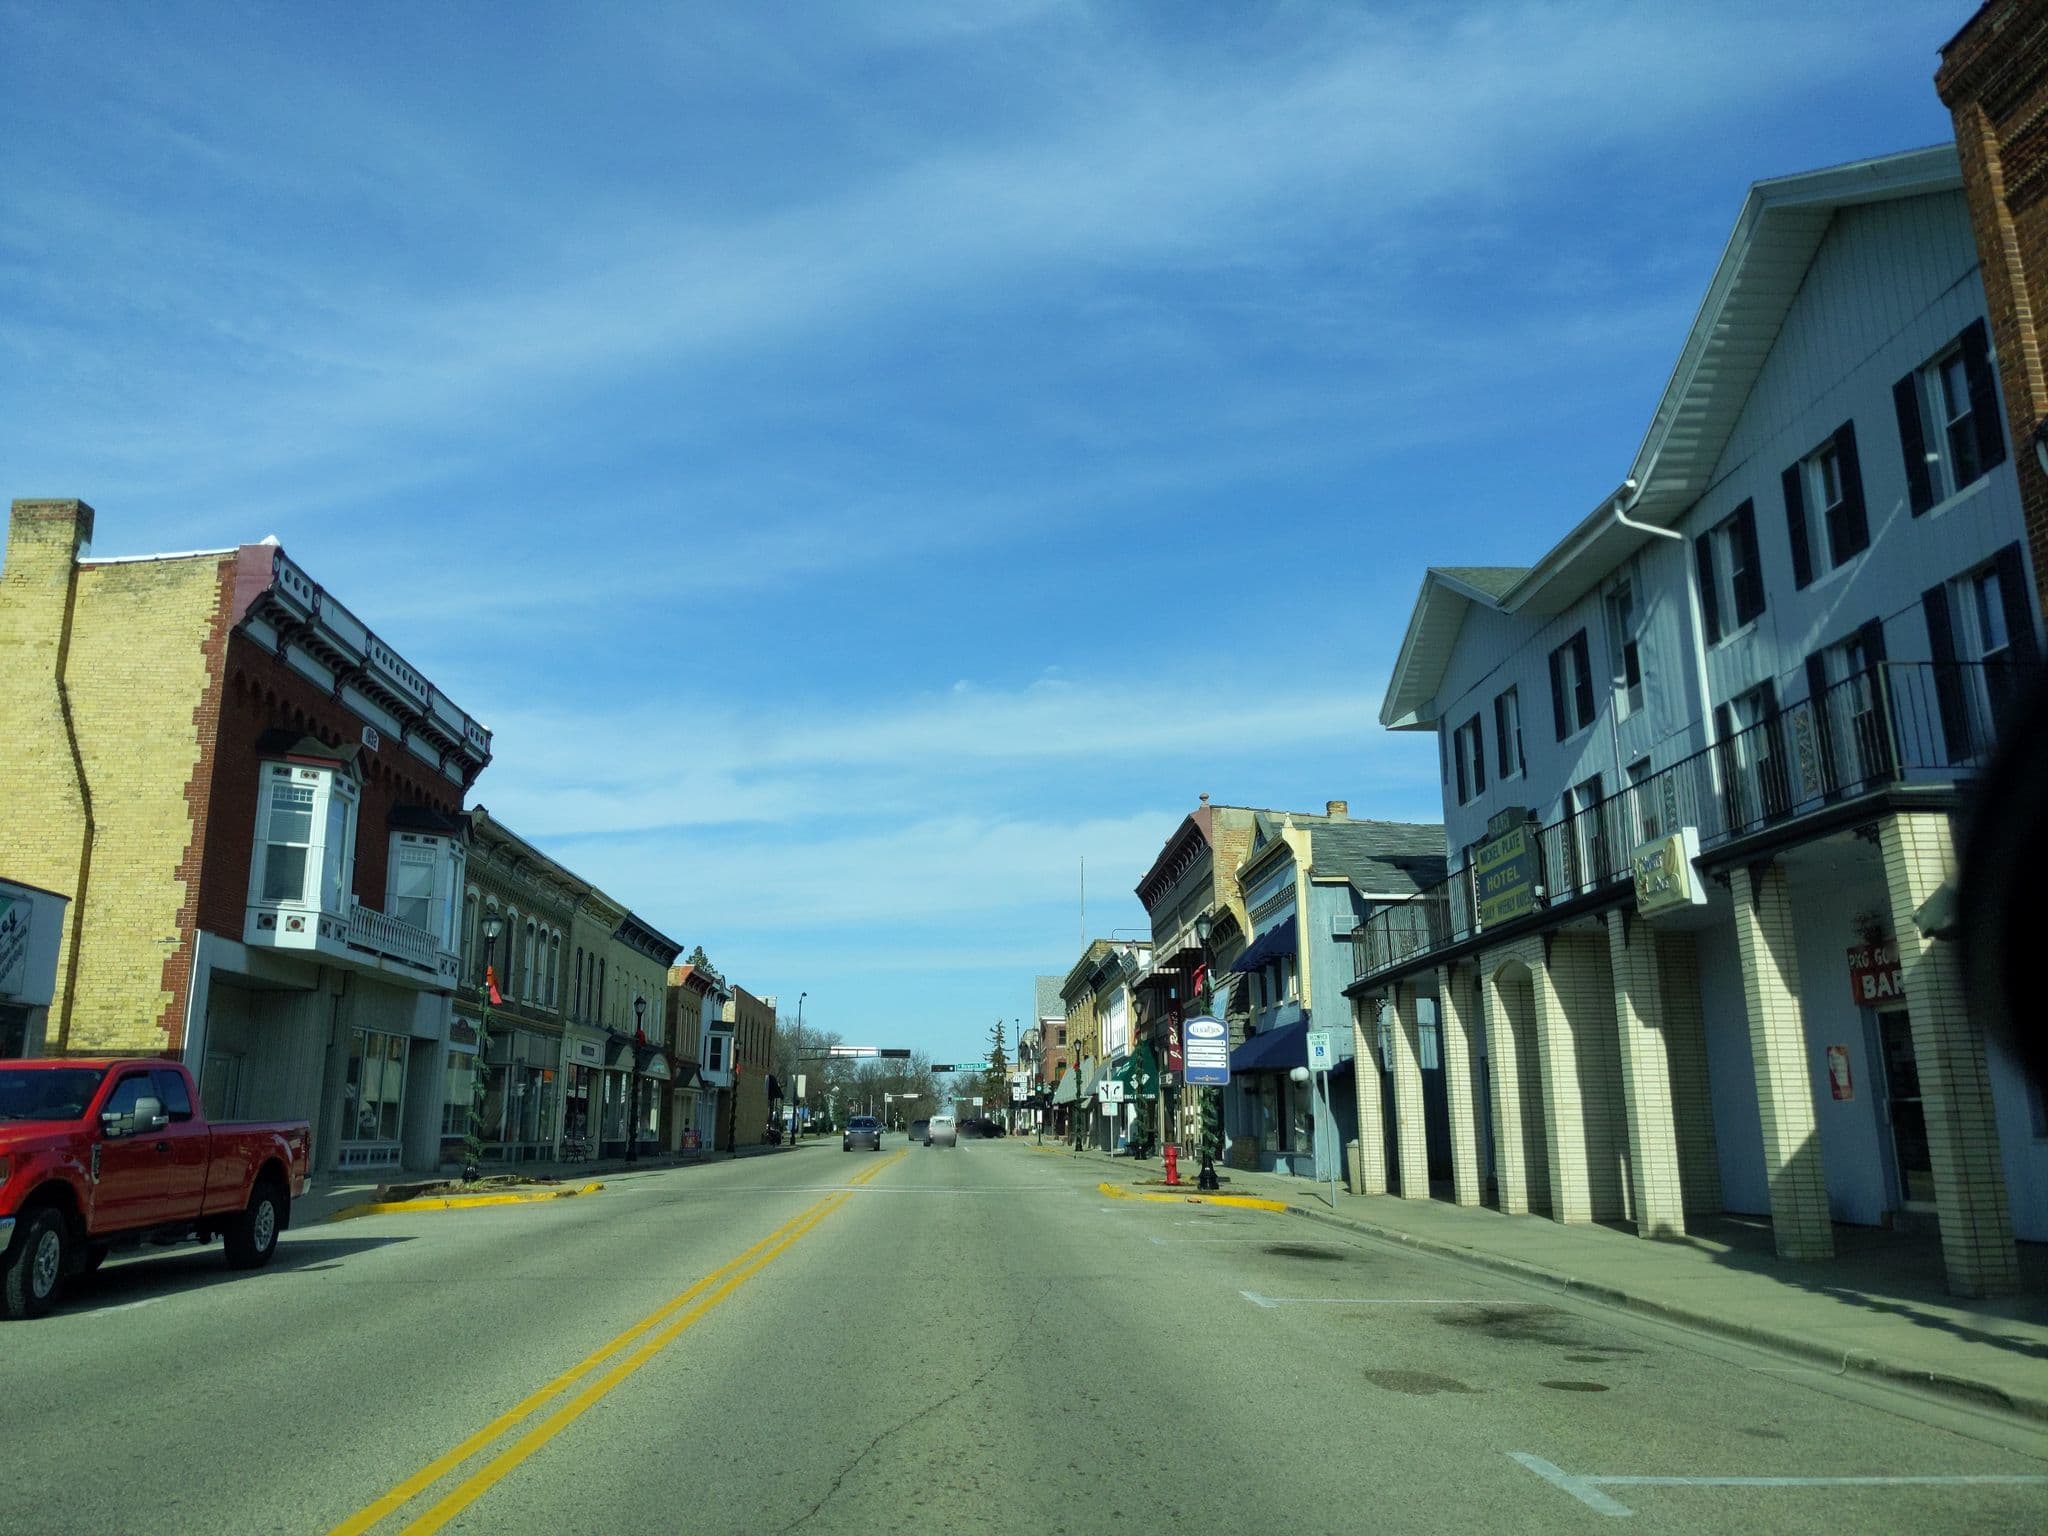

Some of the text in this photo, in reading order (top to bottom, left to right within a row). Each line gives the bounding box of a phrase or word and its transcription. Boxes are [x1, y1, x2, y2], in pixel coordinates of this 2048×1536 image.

[1502, 832, 1521, 854] PLATE
[1487, 865, 1521, 891] HOTEL
[1849, 951, 1869, 968] PKG
[1861, 970, 1904, 999] BAR
